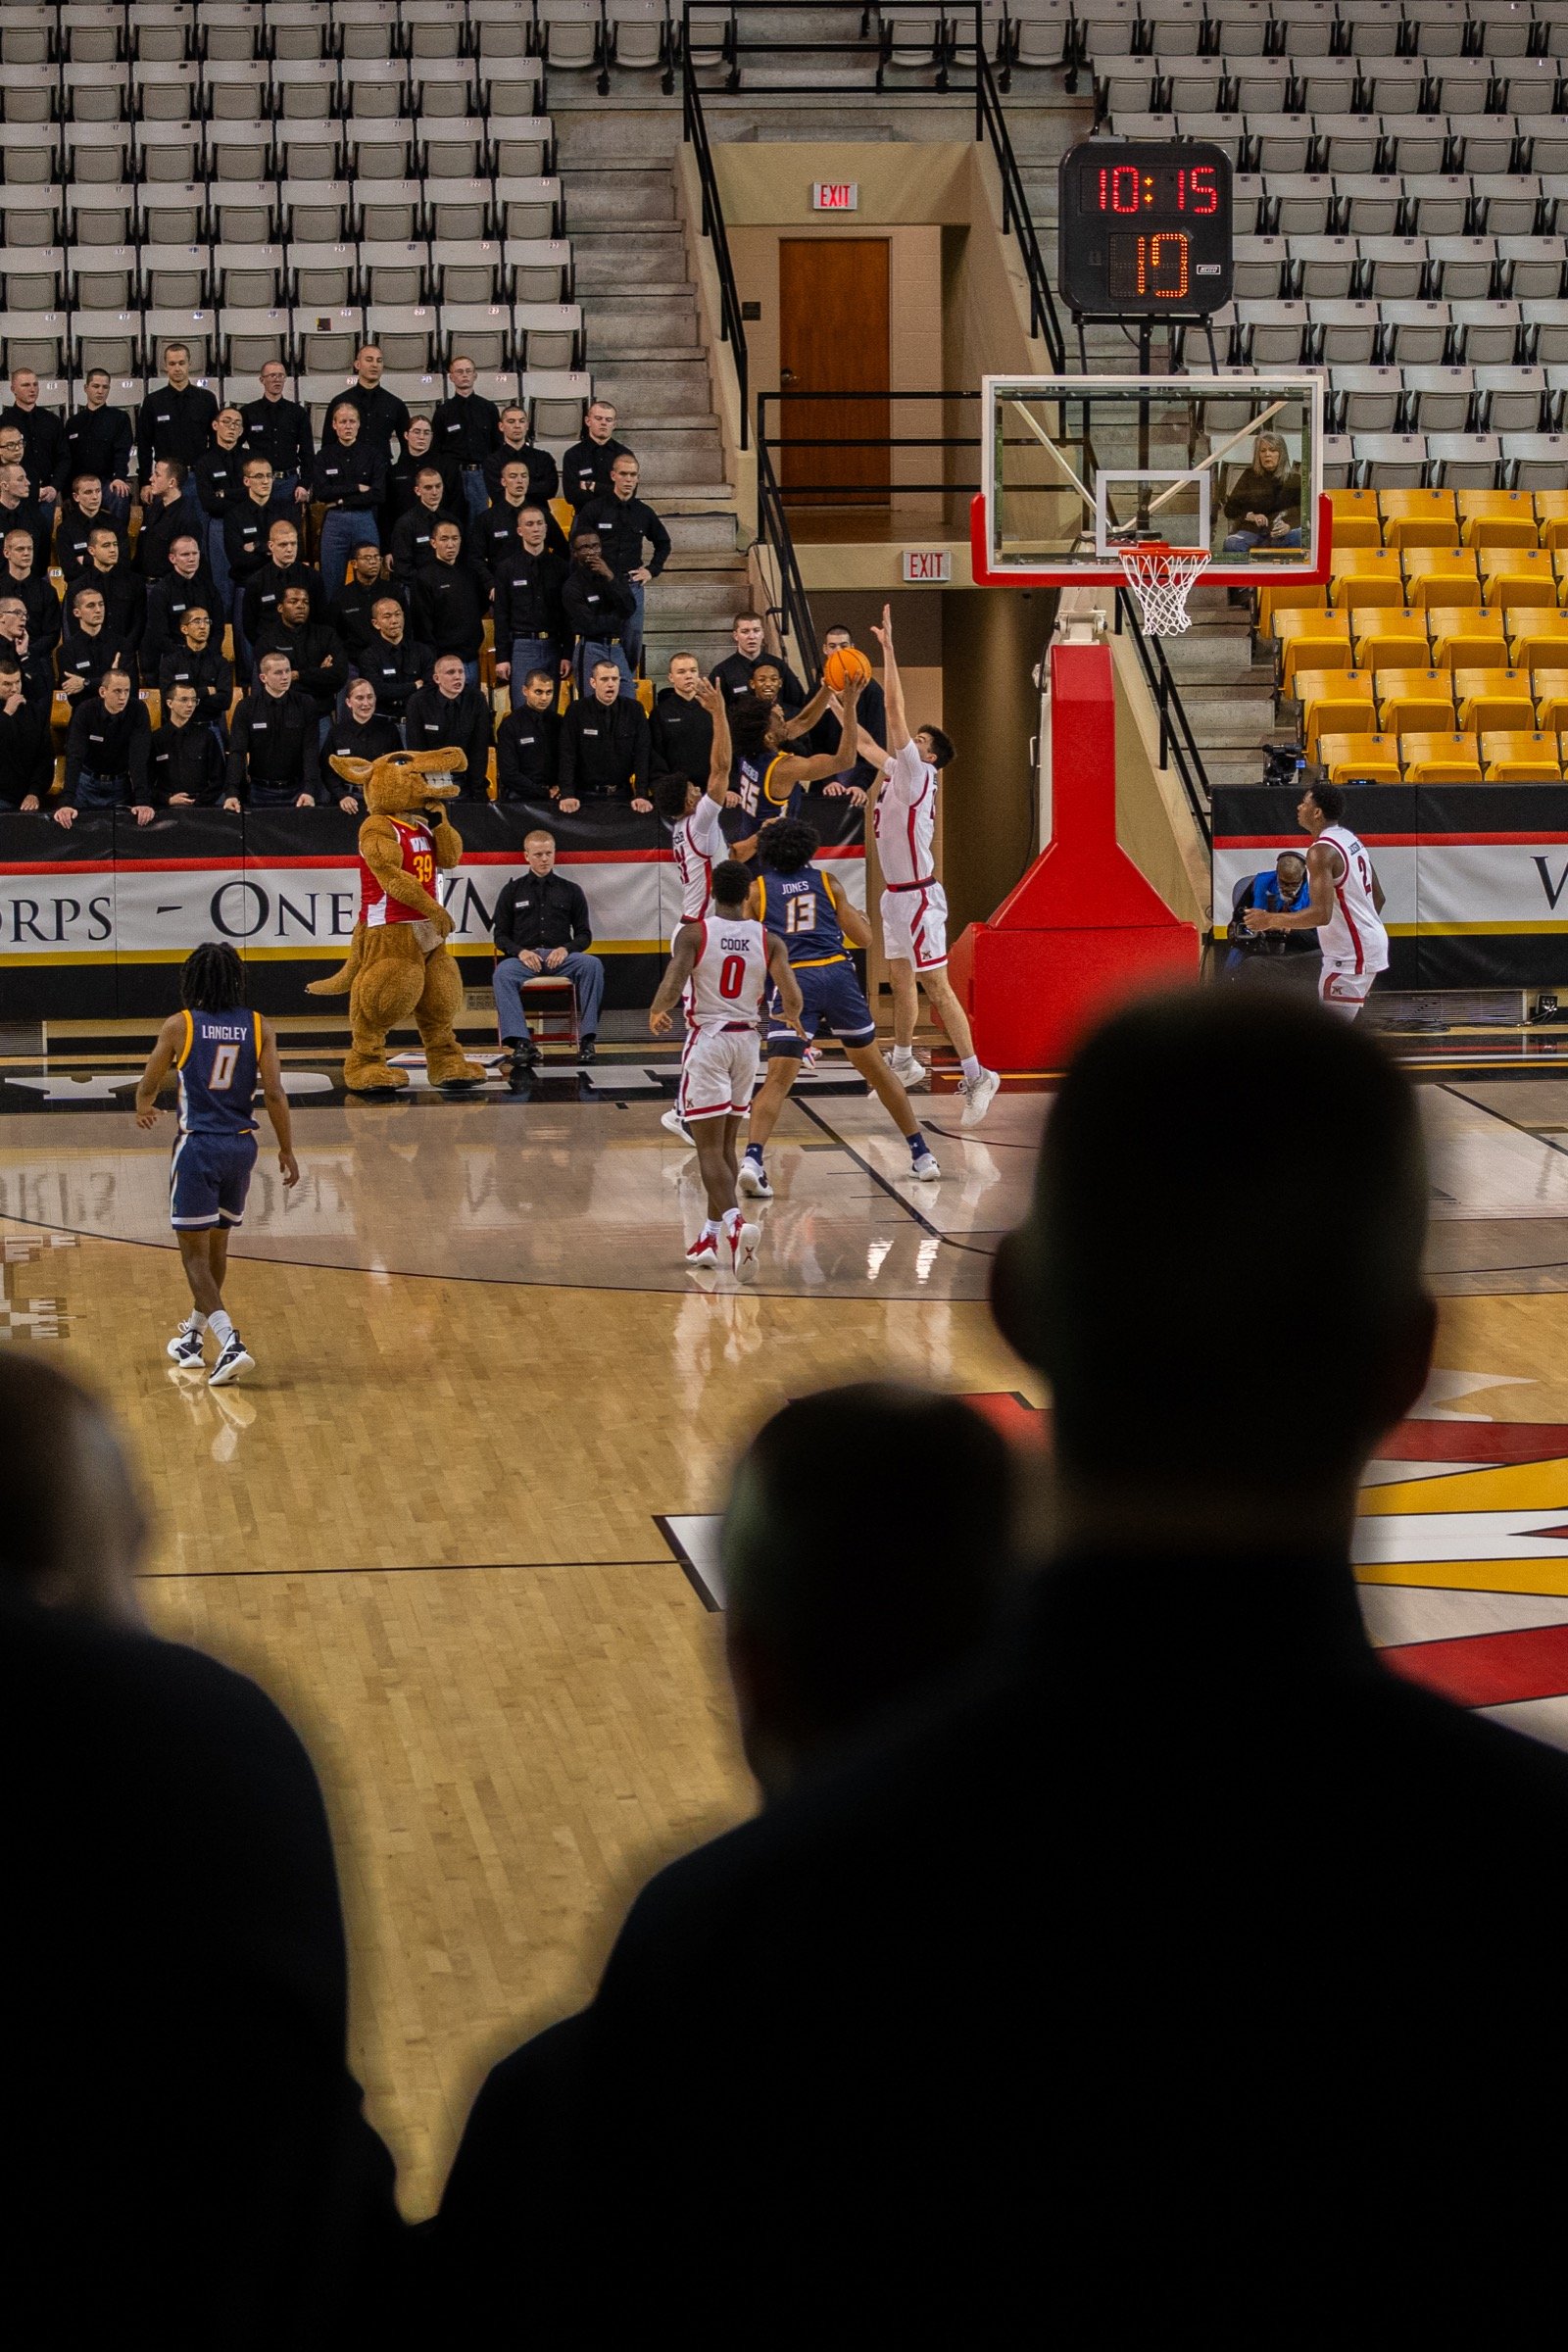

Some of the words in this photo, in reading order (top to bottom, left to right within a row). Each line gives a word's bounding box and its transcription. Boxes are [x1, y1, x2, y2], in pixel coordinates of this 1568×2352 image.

[820, 184, 851, 207] EXIT
[1099, 166, 1218, 214] 10:15
[910, 554, 943, 578] EXIT
[413, 854, 433, 882] 39
[1357, 855, 1372, 896] 2
[782, 881, 809, 895] JONES
[0, 897, 112, 942] RPS
[785, 893, 816, 933] 13
[720, 938, 750, 951] COOK
[719, 955, 746, 999] 0
[202, 1025, 247, 1041] LANGLEY
[208, 1045, 241, 1090] 0
